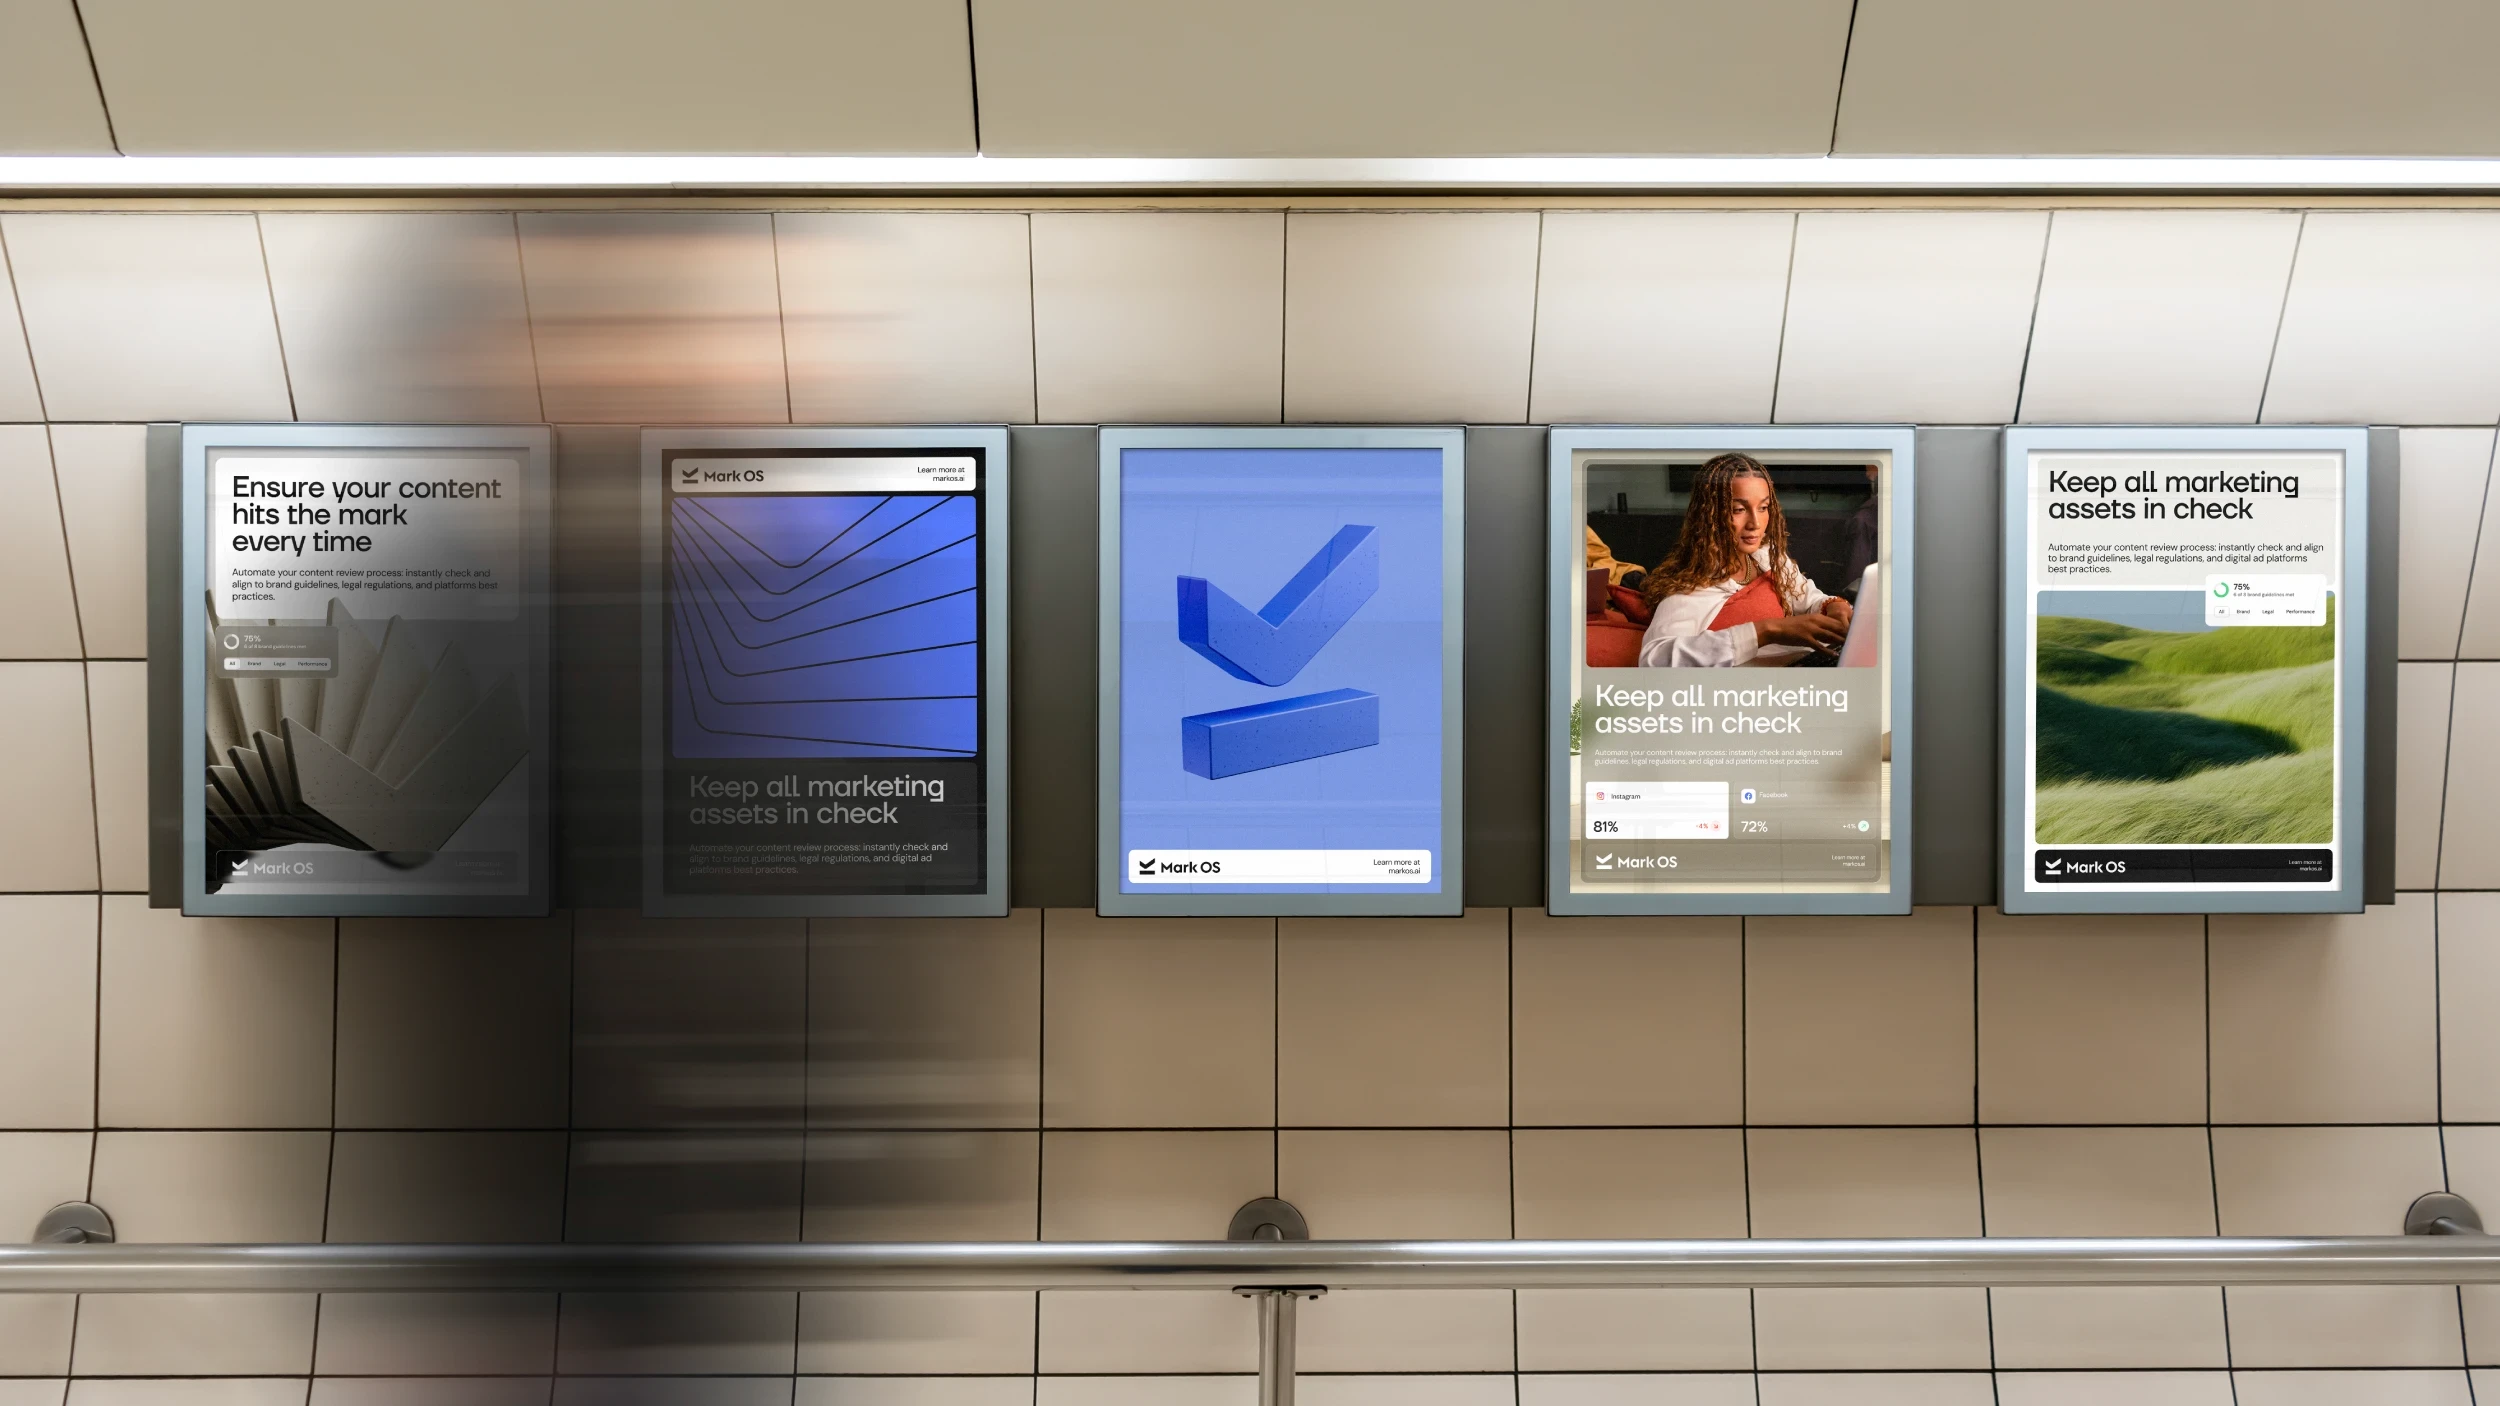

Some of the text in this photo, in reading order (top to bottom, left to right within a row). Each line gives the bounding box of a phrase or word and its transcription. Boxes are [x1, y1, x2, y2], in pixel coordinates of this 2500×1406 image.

[704, 470, 764, 482] Mark OS
[234, 476, 501, 503] Ensure your content
[2050, 471, 2298, 499] Keep all marketing
[234, 502, 407, 525] hits the mark
[2049, 497, 2253, 519] assets in check
[233, 530, 372, 557] every time
[2093, 545, 2112, 553] your
[2151, 543, 2178, 551] review
[2180, 545, 2216, 553] process:
[2219, 543, 2255, 553] instantly
[2258, 543, 2283, 551] check
[2304, 544, 2323, 553] align
[2087, 554, 2131, 564] guidelines,
[2134, 554, 2153, 564] legal
[2156, 554, 2204, 564] regulations,
[2207, 554, 2222, 562] and
[2225, 554, 2250, 564] digital
[2267, 554, 2307, 564] platforms
[278, 570, 297, 578] your
[406, 569, 442, 578] instantly
[445, 569, 471, 577] check
[474, 569, 490, 577] and
[2070, 563, 2111, 574] practices.
[232, 580, 252, 590] align
[294, 580, 339, 590] guidelines,
[342, 581, 362, 590] legal
[364, 581, 413, 591] regulations,
[435, 581, 476, 591] platforms
[479, 581, 498, 589] best
[232, 592, 275, 602] practices.
[1596, 684, 1848, 713] Keep all marketing
[1596, 711, 1802, 733] assets in check
[1729, 749, 1758, 757] instantly
[1796, 749, 1811, 757] align
[1632, 758, 1647, 766] legal
[1703, 758, 1724, 766] digital
[691, 774, 944, 803] Keep all marketing
[690, 802, 898, 824] assets in check
[1594, 821, 1618, 832] 81%
[1741, 821, 1768, 832] 72%
[794, 843, 821, 851] review
[863, 843, 900, 853] instantly
[690, 853, 709, 864] align
[723, 853, 749, 862] brand
[752, 854, 797, 864] guidelines,
[800, 854, 819, 864] legal
[822, 854, 871, 864] regulations,
[892, 854, 918, 864] digital
[1618, 856, 1677, 868] Mark OS
[254, 862, 313, 874] Mark OS
[690, 864, 732, 876] platforms
[733, 866, 753, 874] best
[1161, 862, 1220, 873] Mark OS
[2067, 861, 2126, 873] Mark OS
